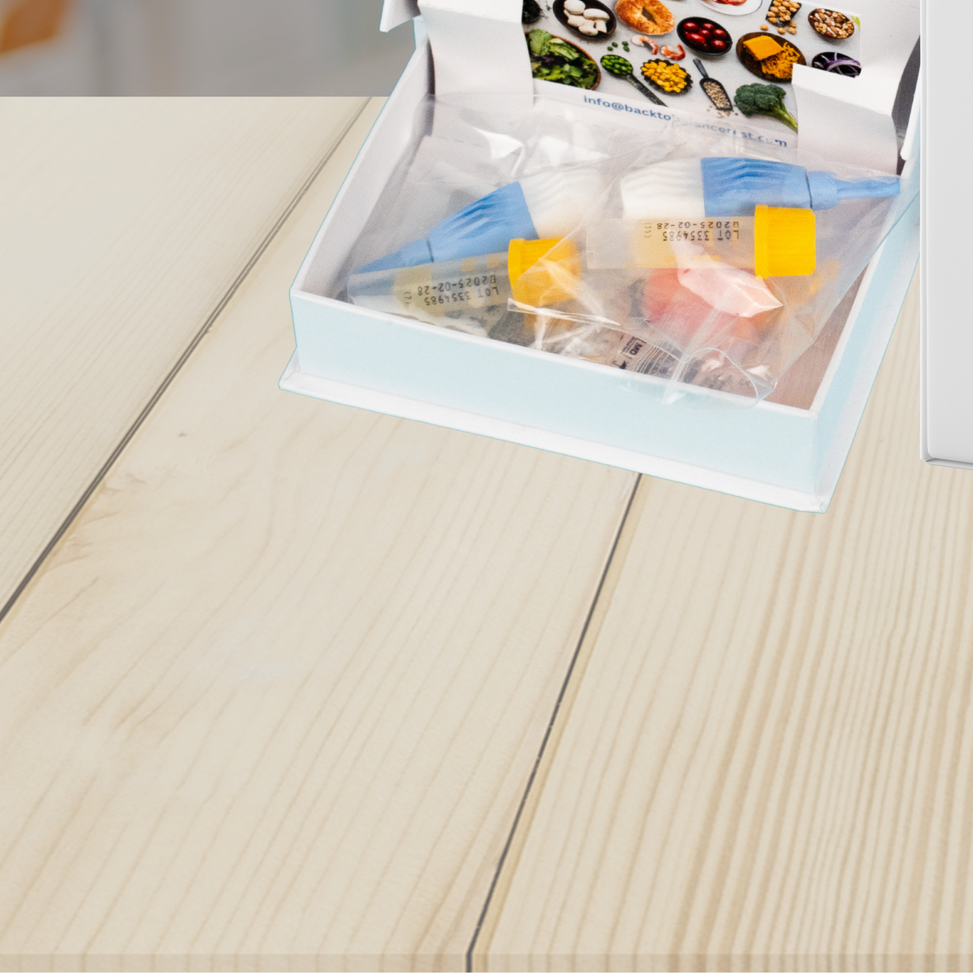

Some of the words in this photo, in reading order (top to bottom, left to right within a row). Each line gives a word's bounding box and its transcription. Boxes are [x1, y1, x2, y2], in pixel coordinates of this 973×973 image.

[662, 230, 710, 241] 3354985
[717, 230, 739, 241] LOT
[477, 285, 499, 298] LOT
[424, 290, 471, 306] 3354985
